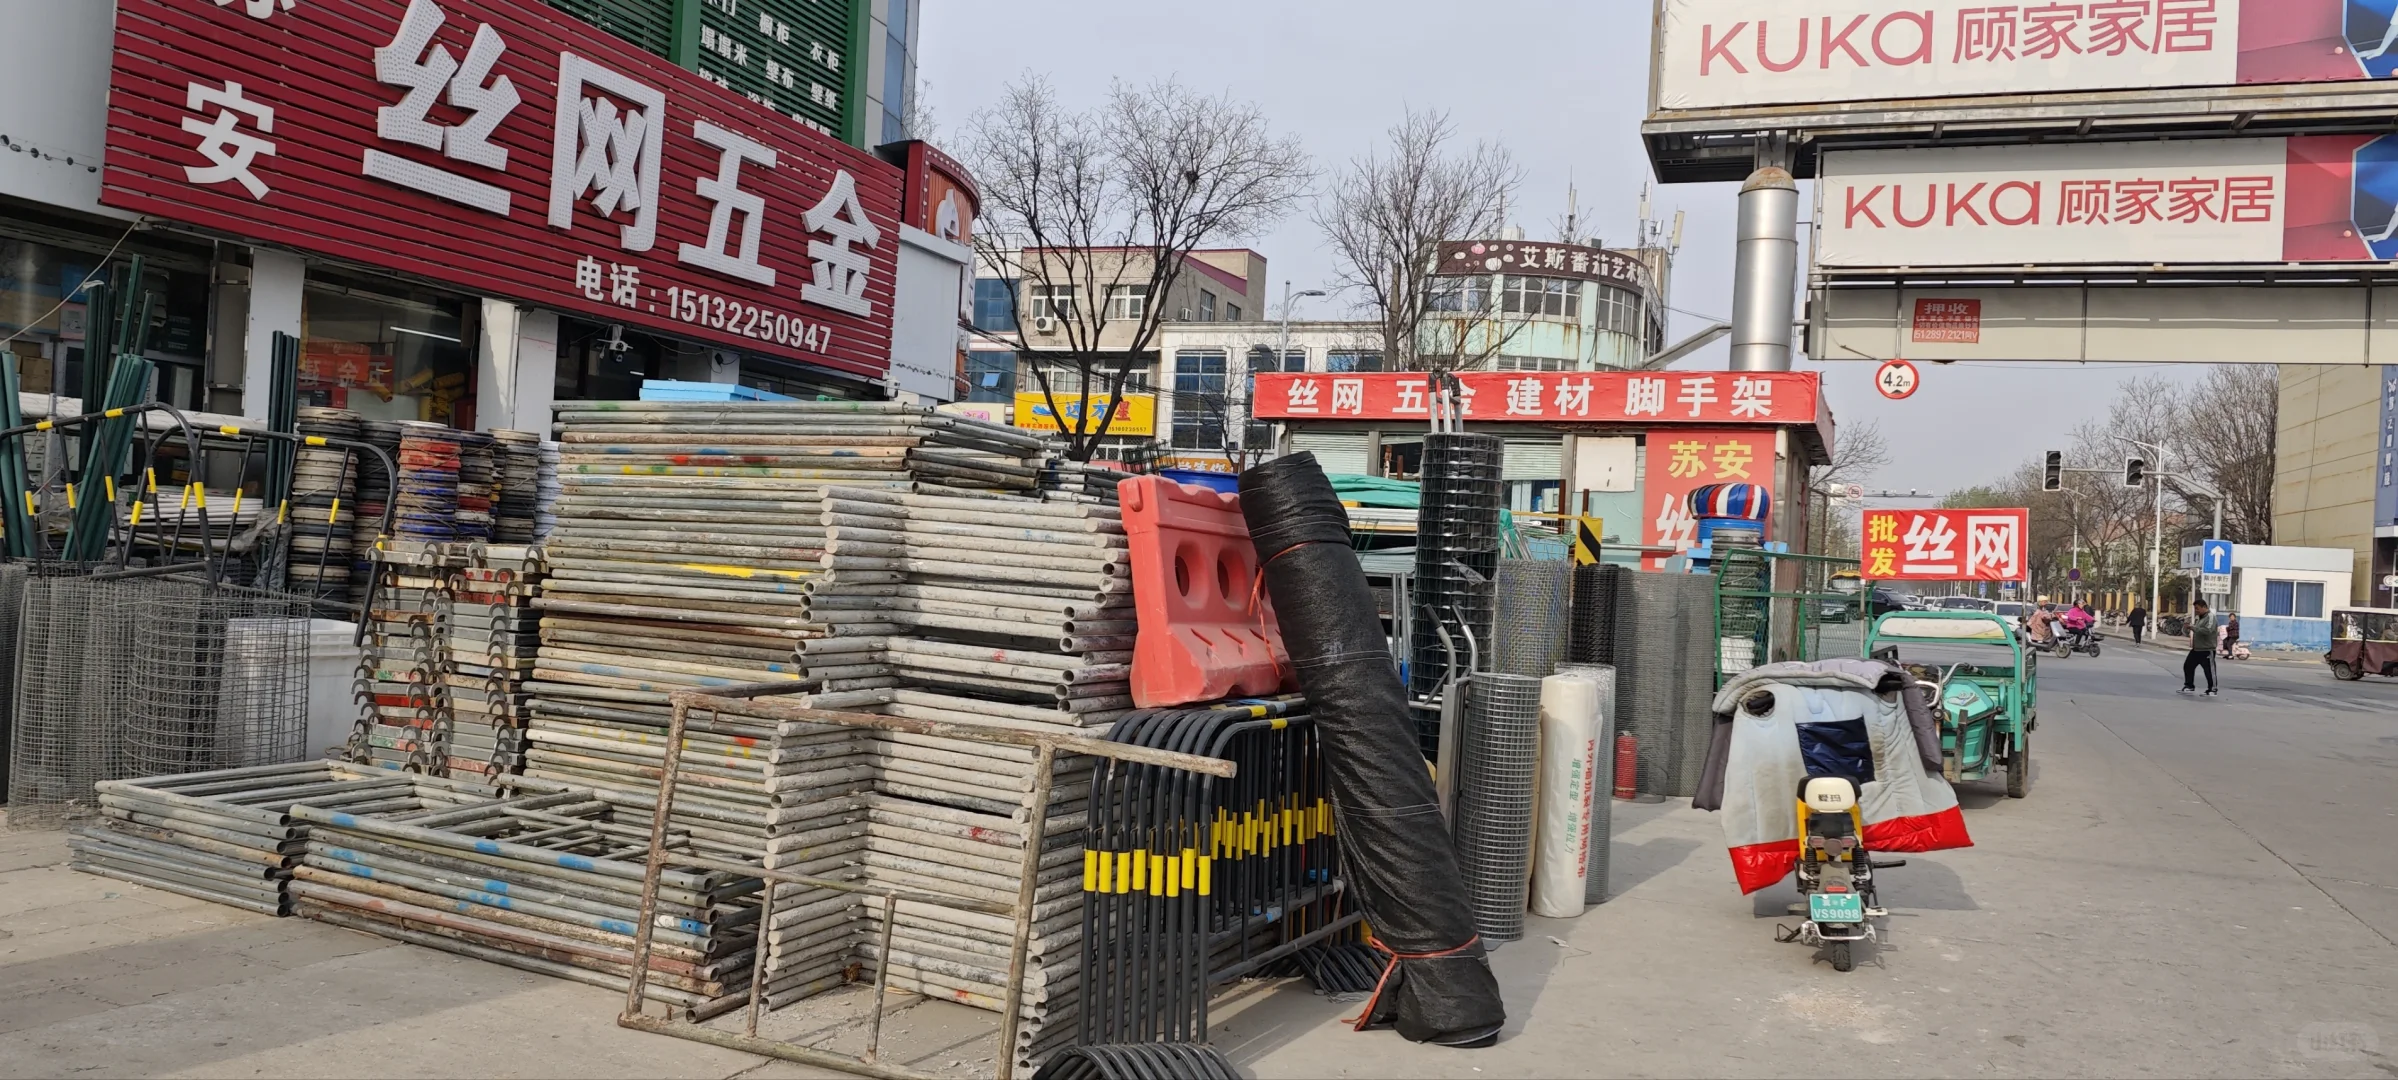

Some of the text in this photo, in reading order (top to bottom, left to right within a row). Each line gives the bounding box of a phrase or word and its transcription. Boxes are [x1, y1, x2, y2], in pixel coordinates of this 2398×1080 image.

[707, 0, 840, 73] 门 橱柜 衣柜
[1952, 0, 2218, 64] 顾家家居
[701, 24, 748, 67] 塌塌米
[765, 59, 795, 90] 壁布
[810, 82, 838, 112] 壁纸
[362, 0, 881, 317] 丝网五金
[2056, 175, 2275, 227] 顾家家居
[1288, 376, 1775, 418] 丝网 五金 建材 脚手架
[1884, 371, 1911, 387] 4.2m
[1667, 440, 1754, 480] 苏安
[1868, 514, 1899, 577] 批发
[1902, 513, 2020, 578] 丝网
[1813, 908, 1860, 919] VS9098
